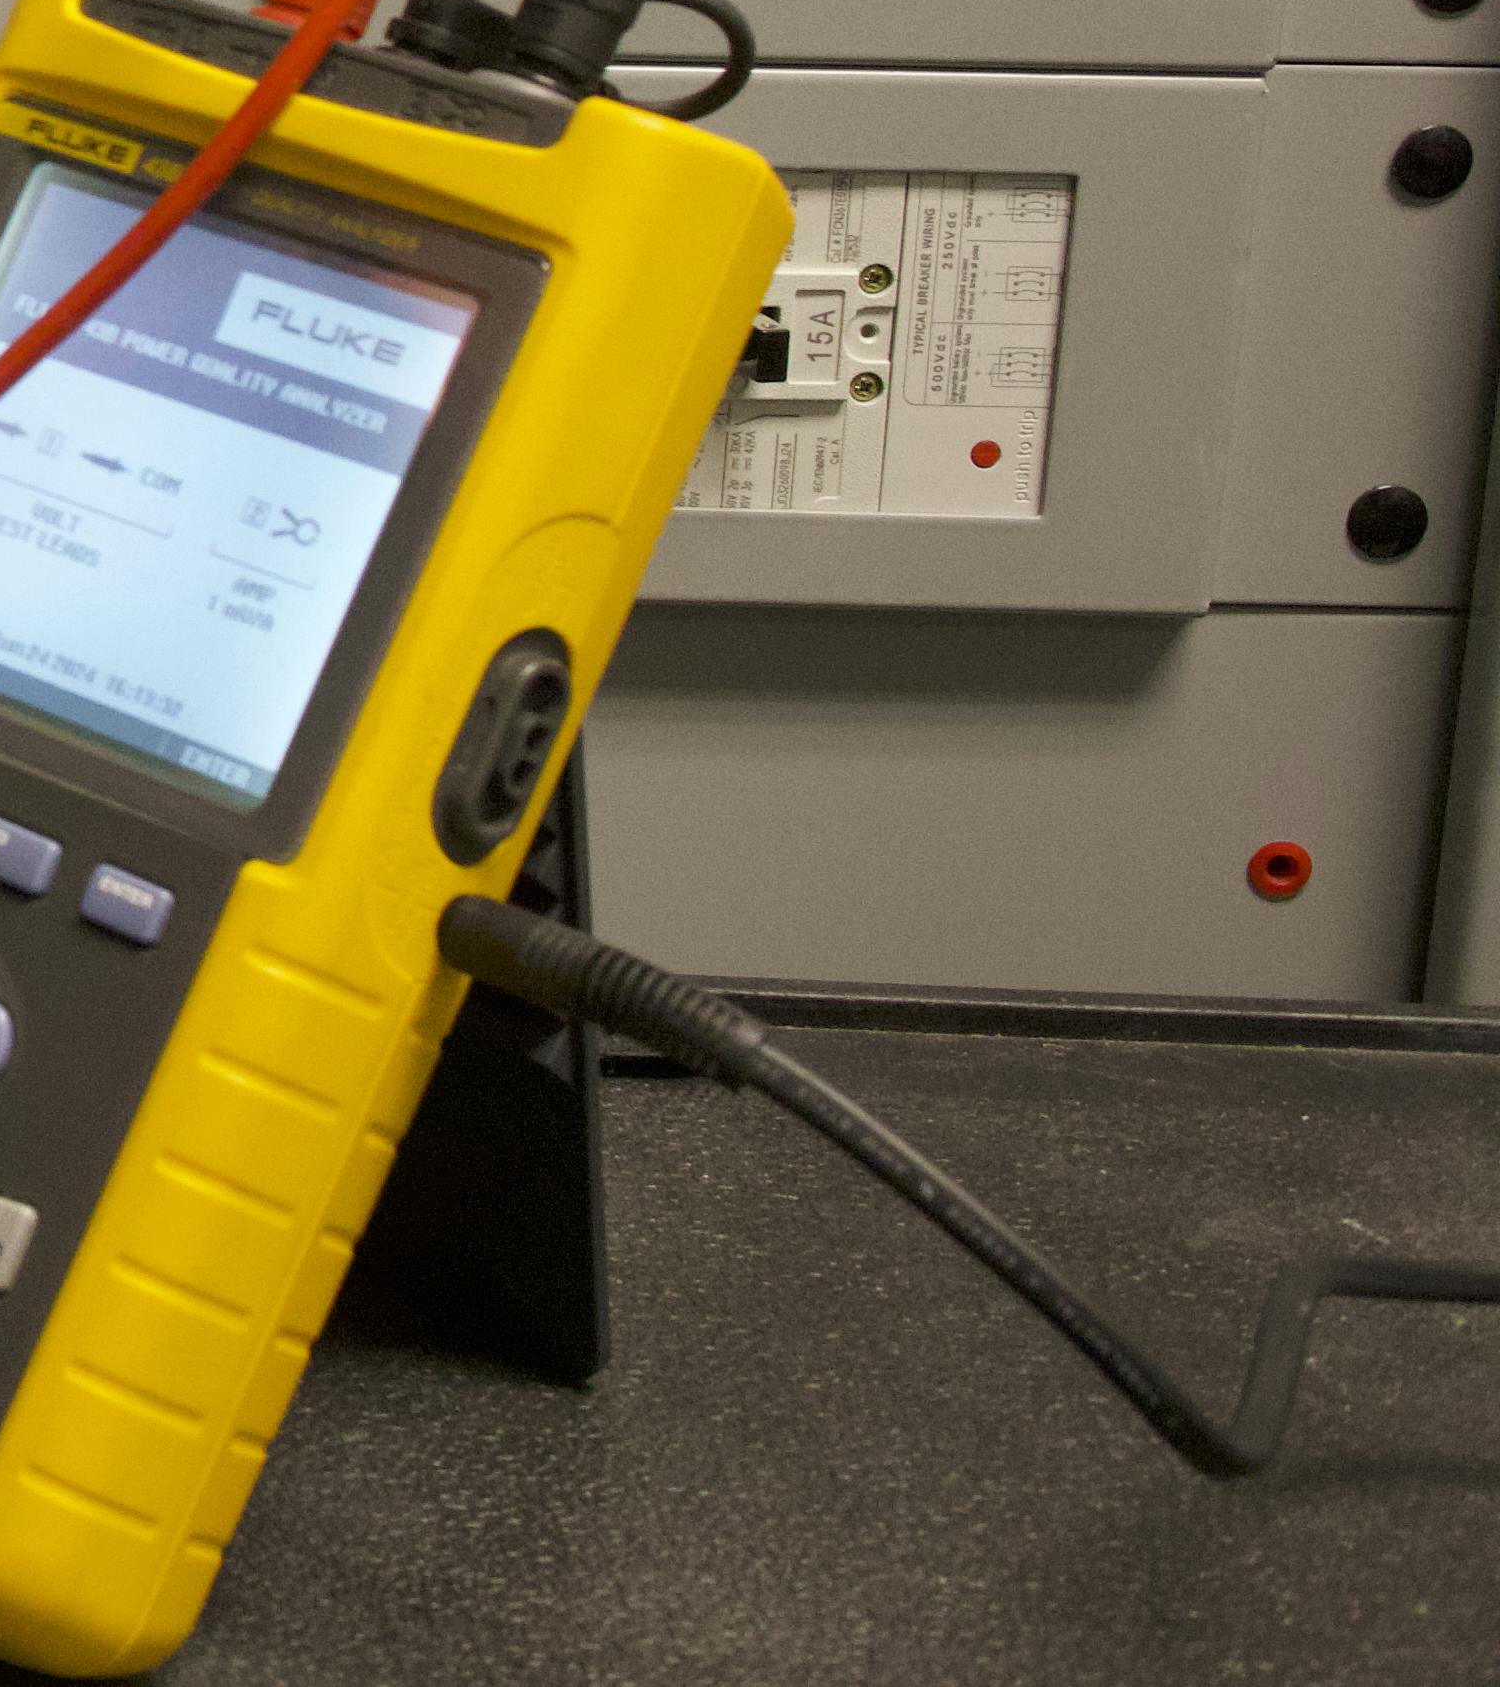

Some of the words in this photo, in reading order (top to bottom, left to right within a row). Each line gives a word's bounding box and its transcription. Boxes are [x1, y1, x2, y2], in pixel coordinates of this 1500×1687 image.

[27, 118, 128, 164] FLUKE
[922, 207, 936, 249] WIRING
[917, 253, 932, 306] BREAKER
[252, 299, 407, 367] FLUKE
[806, 310, 835, 363] 15A
[913, 311, 928, 355] TYPICAL
[190, 350, 277, 397] QUALITY
[276, 383, 388, 434] ANALYZER
[1018, 410, 1038, 439] trip
[1016, 442, 1032, 458] to
[1012, 462, 1031, 503] push
[30, 500, 82, 533] VOLT
[35, 528, 101, 569] LEADS
[178, 744, 251, 789] ENTER
[99, 874, 154, 910] ENTER
